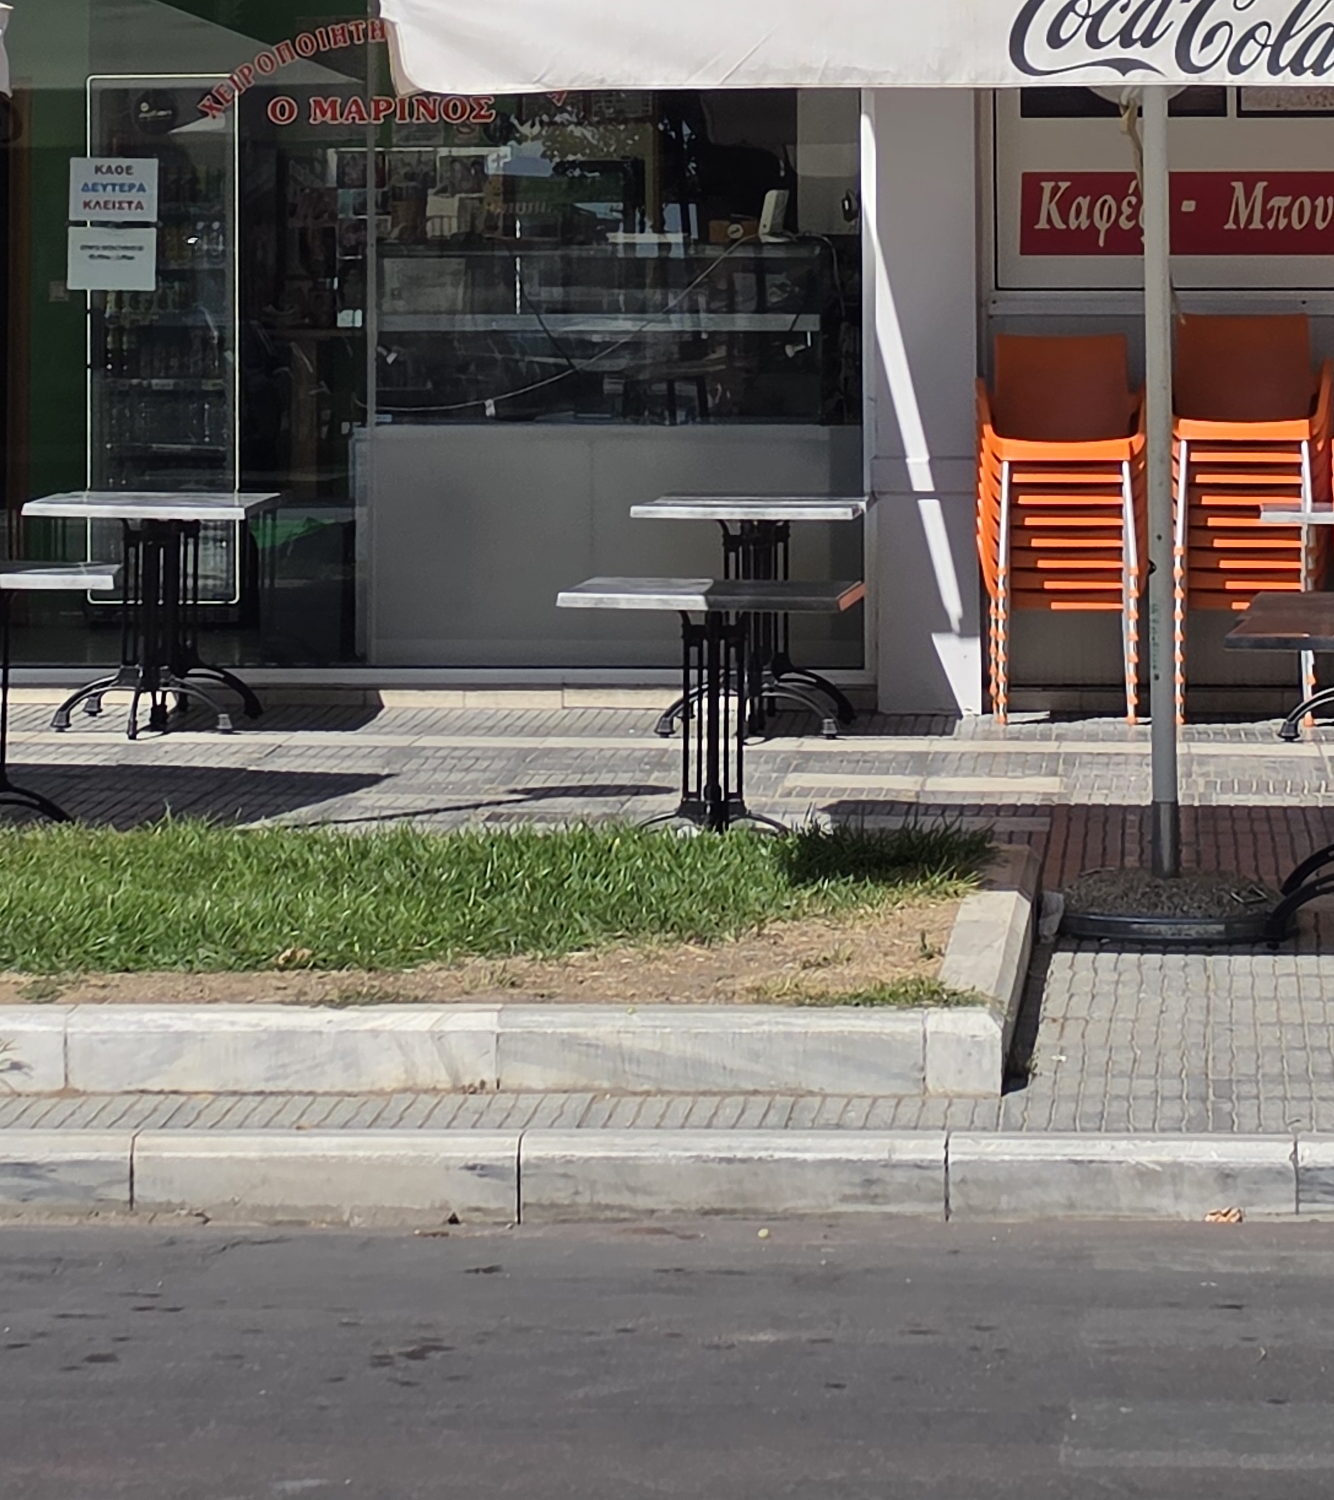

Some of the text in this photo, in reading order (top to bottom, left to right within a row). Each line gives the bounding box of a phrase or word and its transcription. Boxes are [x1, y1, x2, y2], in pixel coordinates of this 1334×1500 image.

[198, 19, 388, 120] ΧΕΙΡΟΠΟΙΗΤΗ
[267, 96, 496, 125] Ο ΜΑΡΙΝΟΣ
[80, 182, 147, 193] ΔΕΥΤΕΡΑ
[82, 200, 145, 211] ΚΛΕΙΣΤΑ
